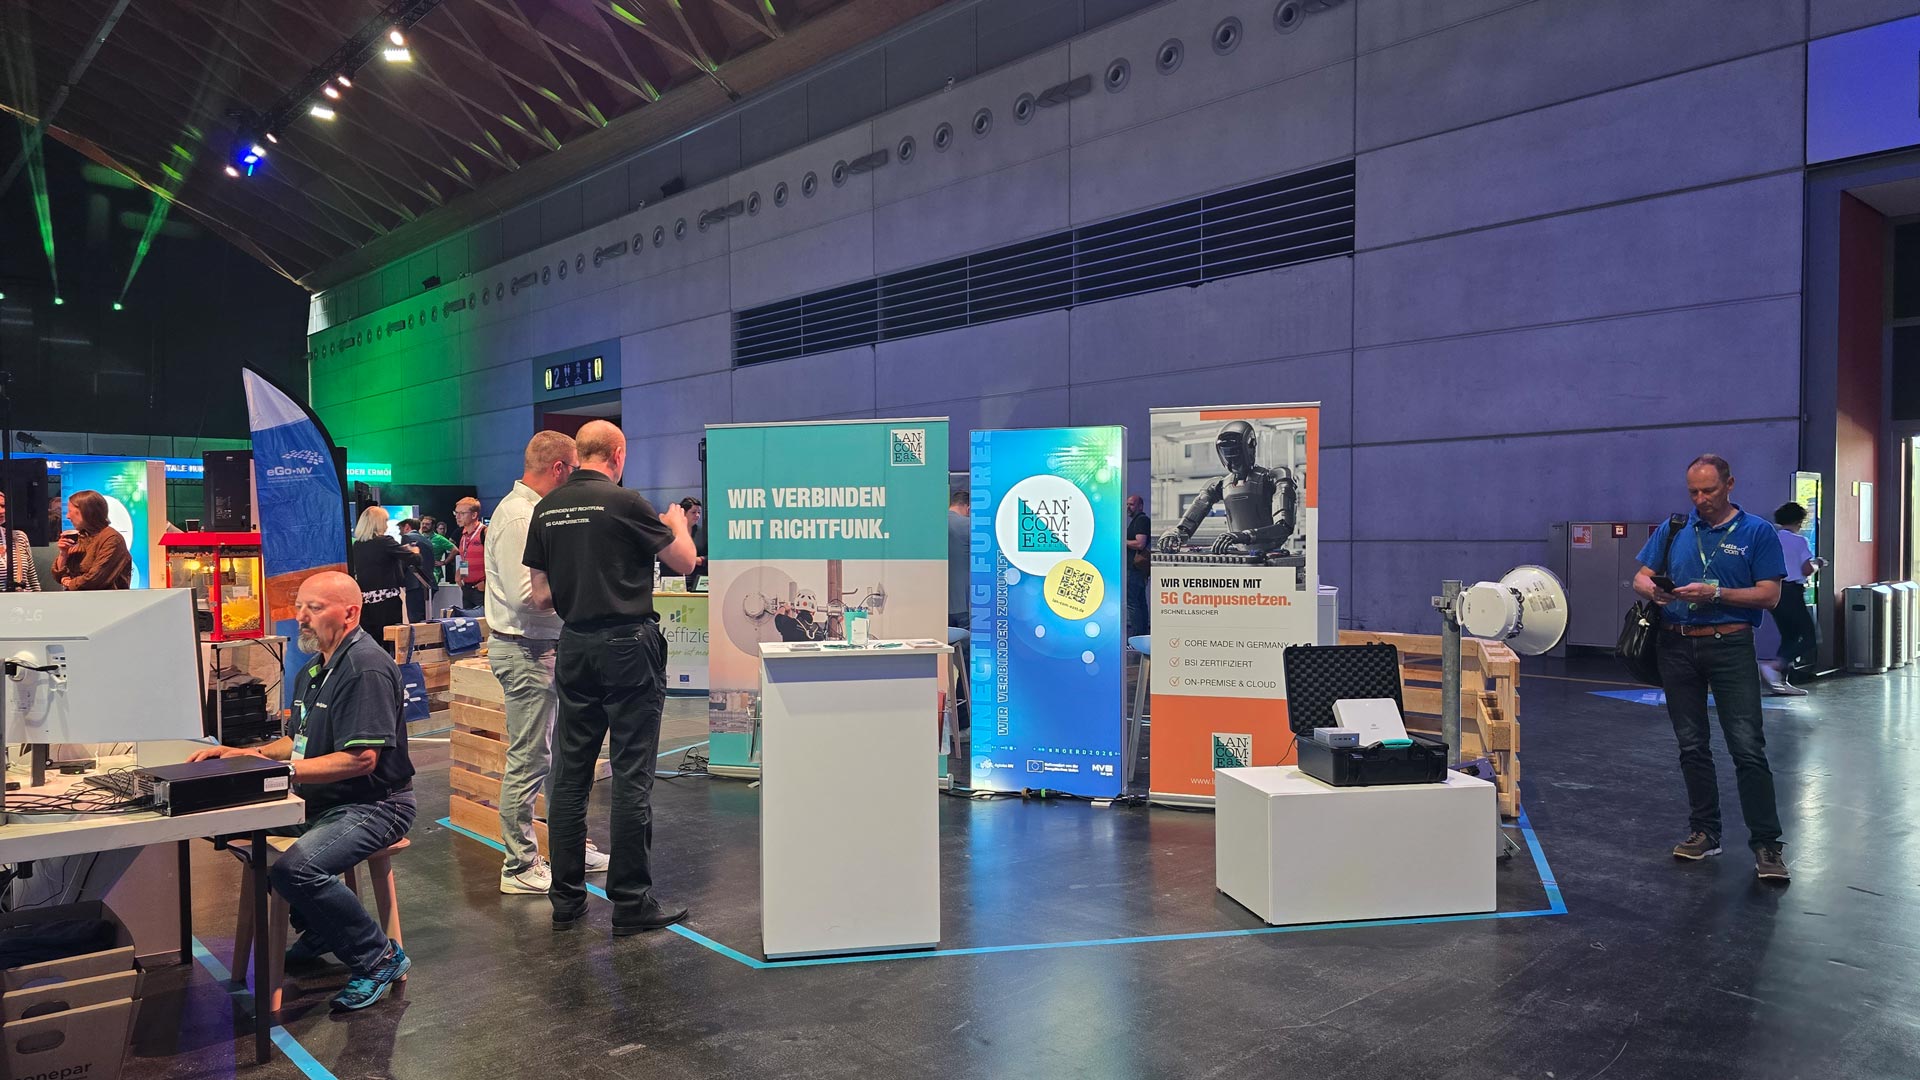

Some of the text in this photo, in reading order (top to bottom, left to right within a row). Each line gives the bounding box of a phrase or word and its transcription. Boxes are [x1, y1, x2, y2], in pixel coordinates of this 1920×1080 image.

[894, 433, 921, 442] LAN
[894, 443, 921, 452] COM
[895, 453, 921, 462] East
[728, 486, 886, 508] WIR VERBINDEN
[1021, 500, 1069, 515] LAN
[728, 518, 890, 540] MIT RICHTFUNK.
[1021, 516, 1069, 532] COM
[1022, 532, 1069, 548] East
[1160, 578, 1262, 588] WIR VERBINDEN MIT
[1160, 592, 1292, 608] 5G Campusnetzen.
[997, 620, 1009, 704] VERBINDEN
[1200, 660, 1254, 668] ZERTIFIZIERT
[1184, 678, 1236, 687] ON-PREMISE
[1246, 680, 1276, 688] CLOUD
[998, 706, 1009, 736] WIR
[1216, 736, 1248, 748] LAN
[1216, 748, 1248, 758] COM
[1216, 758, 1248, 768] East
